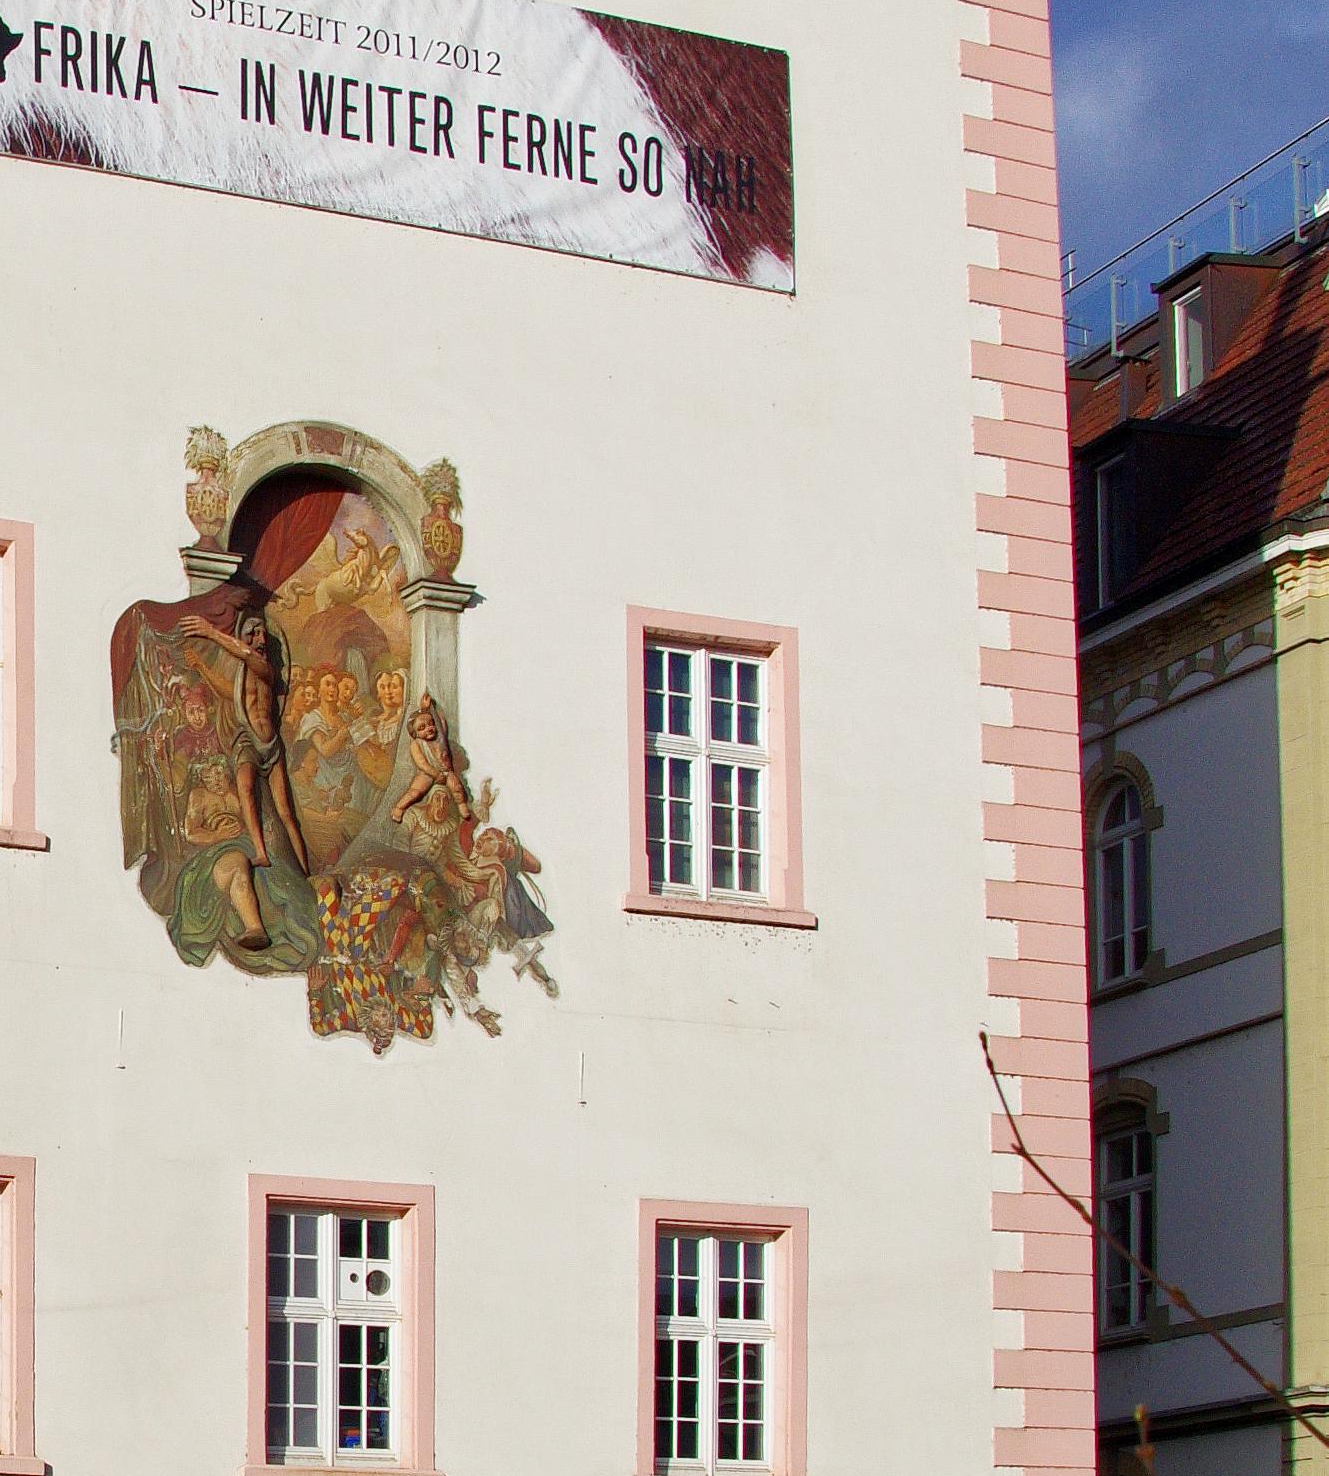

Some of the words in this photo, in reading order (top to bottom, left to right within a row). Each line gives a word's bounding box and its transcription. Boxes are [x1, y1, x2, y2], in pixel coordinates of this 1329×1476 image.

[356, 25, 503, 77] 2011/2012
[239, 57, 276, 126] IN
[298, 69, 456, 160] WEITER
[477, 104, 599, 186] FERNE
[618, 131, 664, 198] SO
[682, 144, 757, 214] NAH
